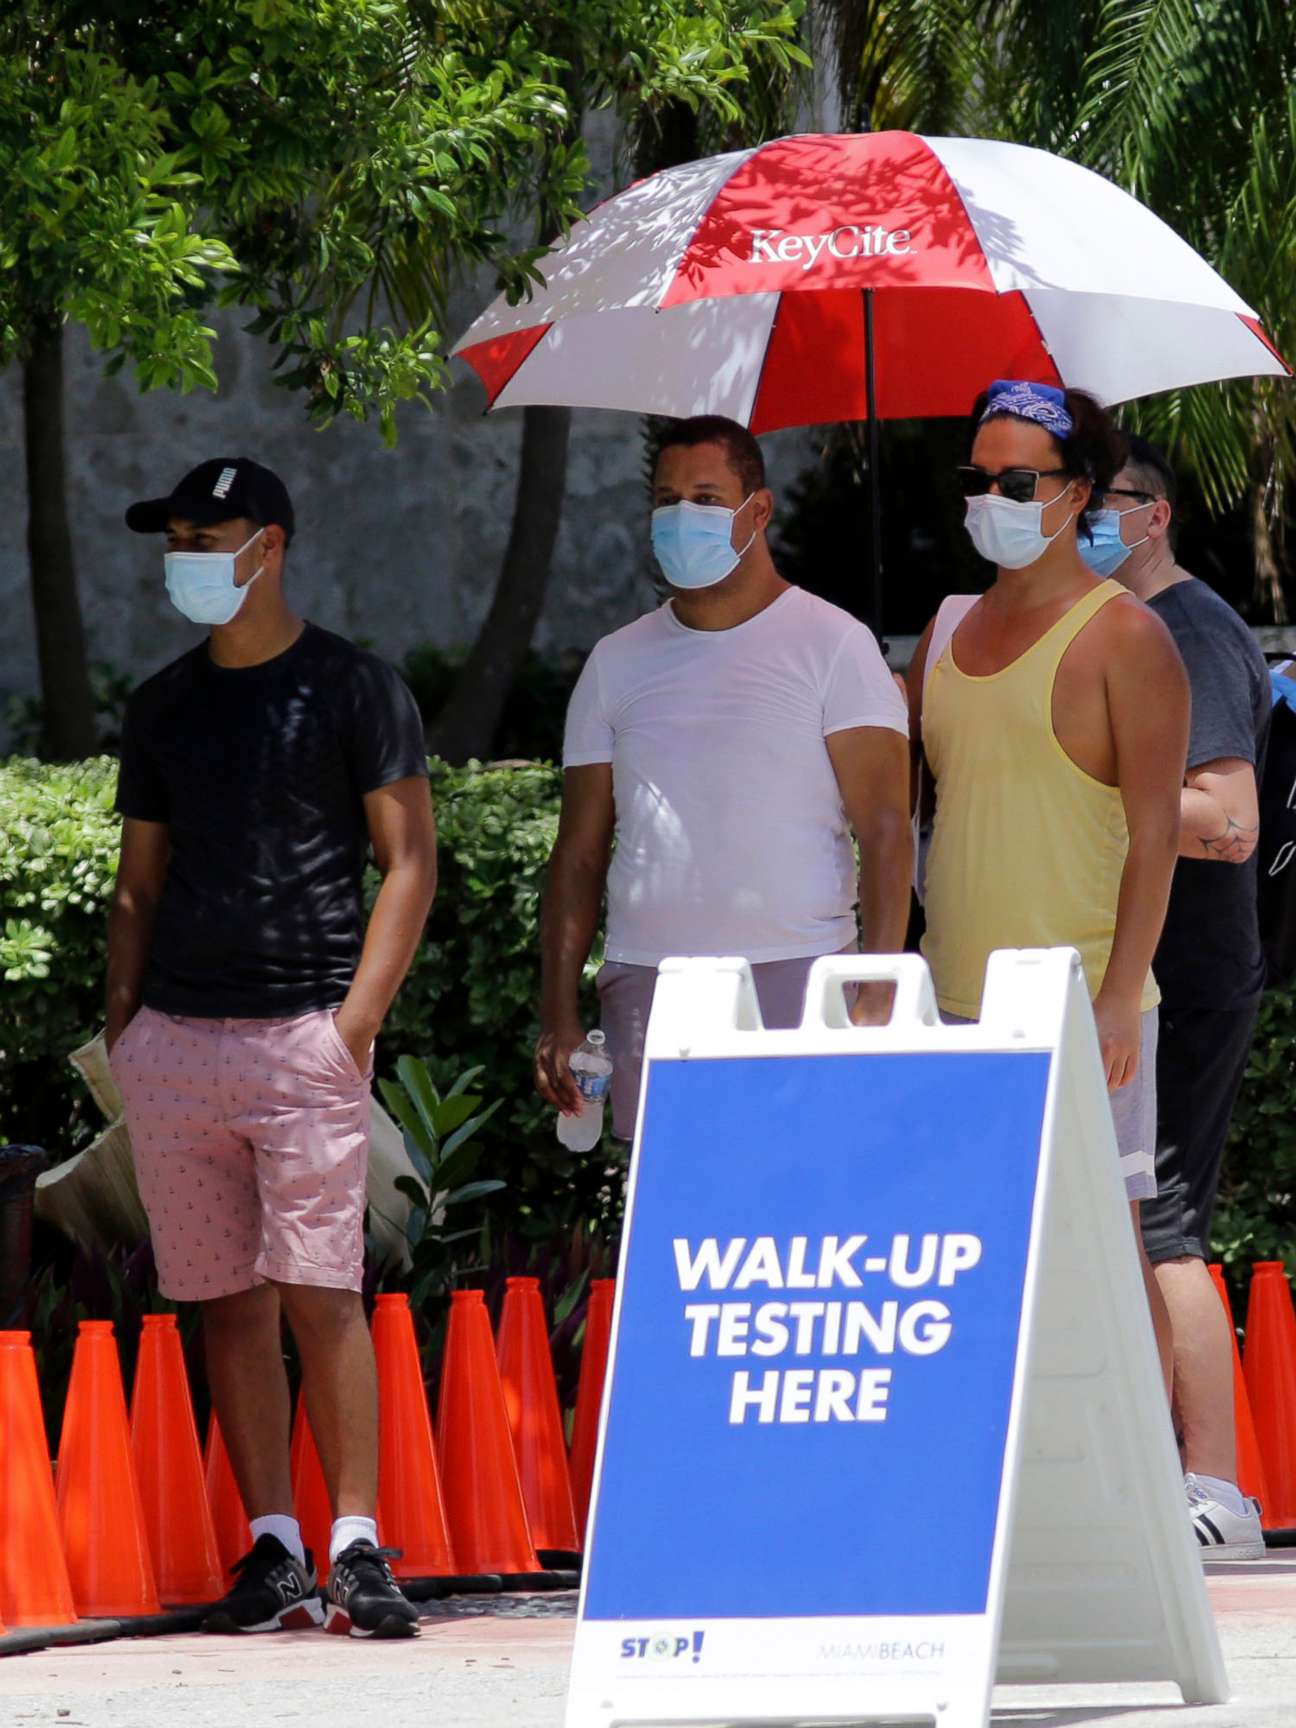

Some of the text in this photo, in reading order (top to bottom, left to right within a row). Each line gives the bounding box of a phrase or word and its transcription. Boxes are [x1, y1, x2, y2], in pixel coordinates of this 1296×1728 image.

[748, 224, 911, 271] KeyCite
[672, 1233, 983, 1291] WALK-UP
[684, 1300, 952, 1357] TESTING
[729, 1368, 892, 1424] HERE
